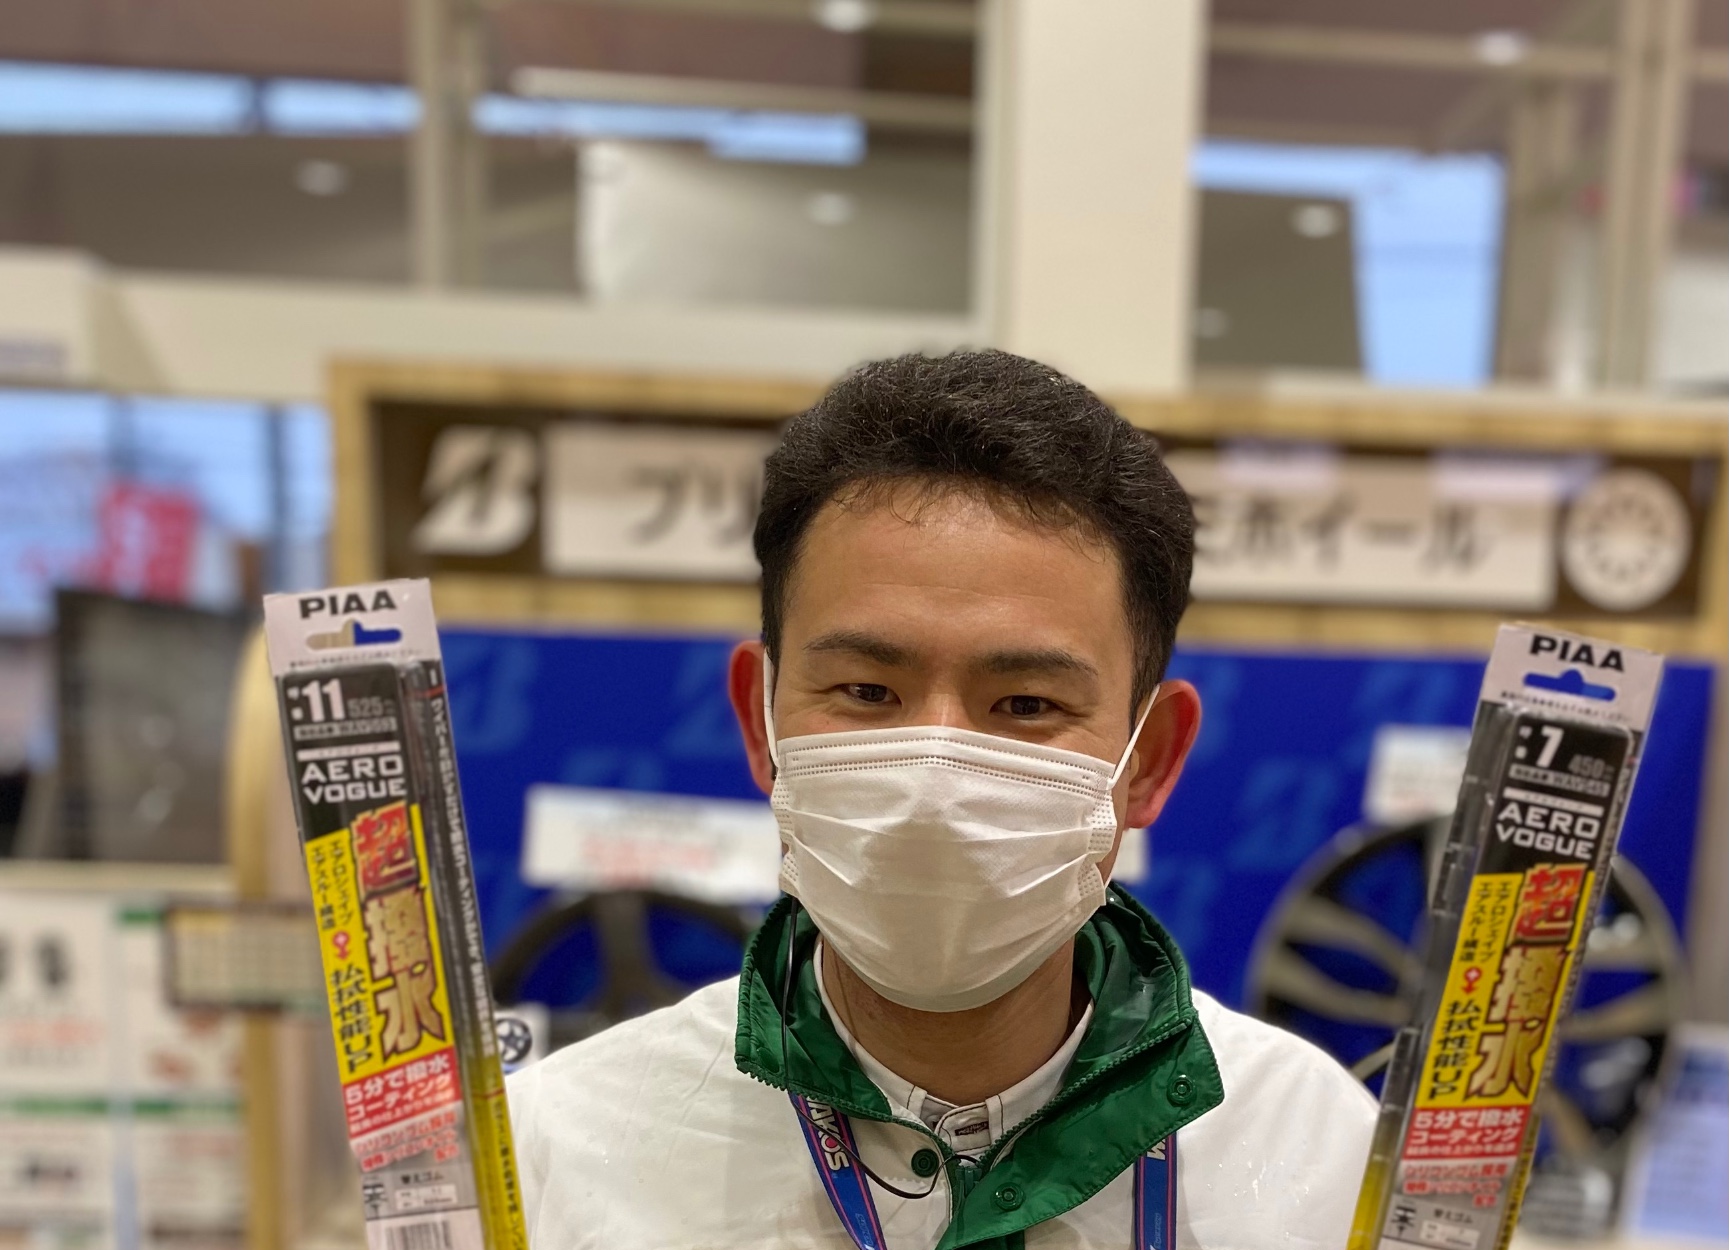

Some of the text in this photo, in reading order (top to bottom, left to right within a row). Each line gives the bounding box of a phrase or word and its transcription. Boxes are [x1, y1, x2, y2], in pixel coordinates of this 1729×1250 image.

[299, 589, 397, 619] PIAA
[1529, 634, 1625, 672] PIAA
[302, 755, 404, 785] AERO
[303, 778, 407, 804] VOGUE
[1497, 802, 1601, 839] AERO
[1495, 823, 1595, 859] VOGUE
[348, 1072, 454, 1122] コーティング
[1410, 1127, 1519, 1145] コーティング
